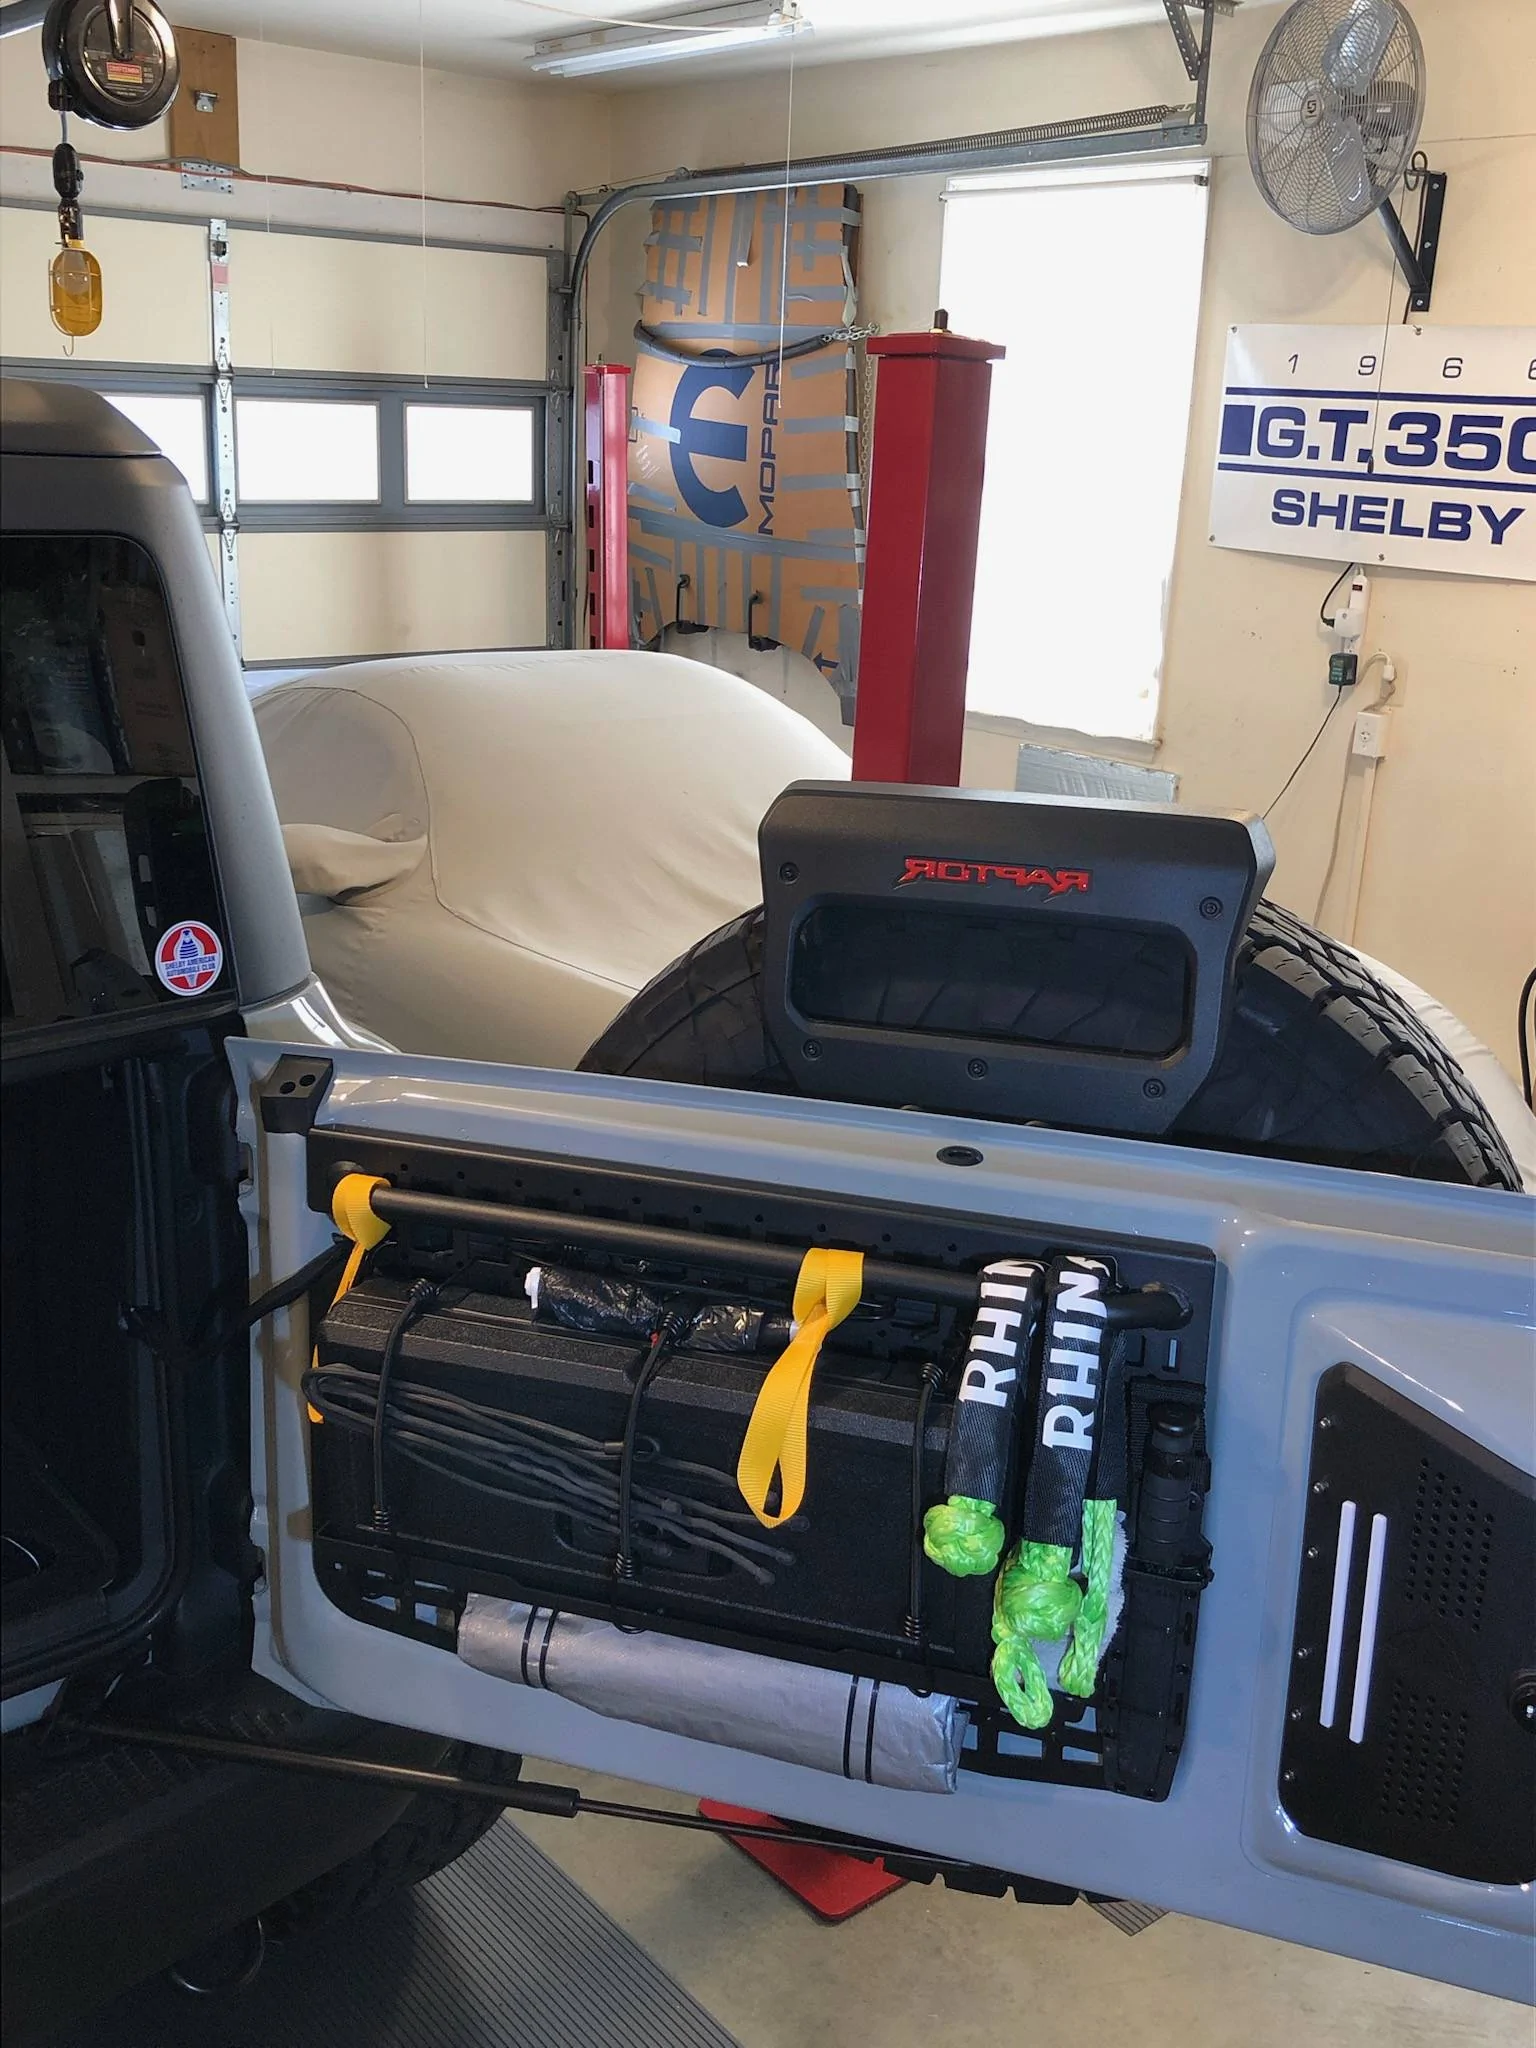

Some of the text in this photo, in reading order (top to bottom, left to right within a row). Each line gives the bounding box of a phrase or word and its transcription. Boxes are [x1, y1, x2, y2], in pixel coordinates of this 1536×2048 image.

[758, 359, 781, 536] MOPAR
[1271, 488, 1526, 545] SHELBY
[165, 960, 186, 970] SHELBY
[1042, 1256, 1111, 1450] RHIN
